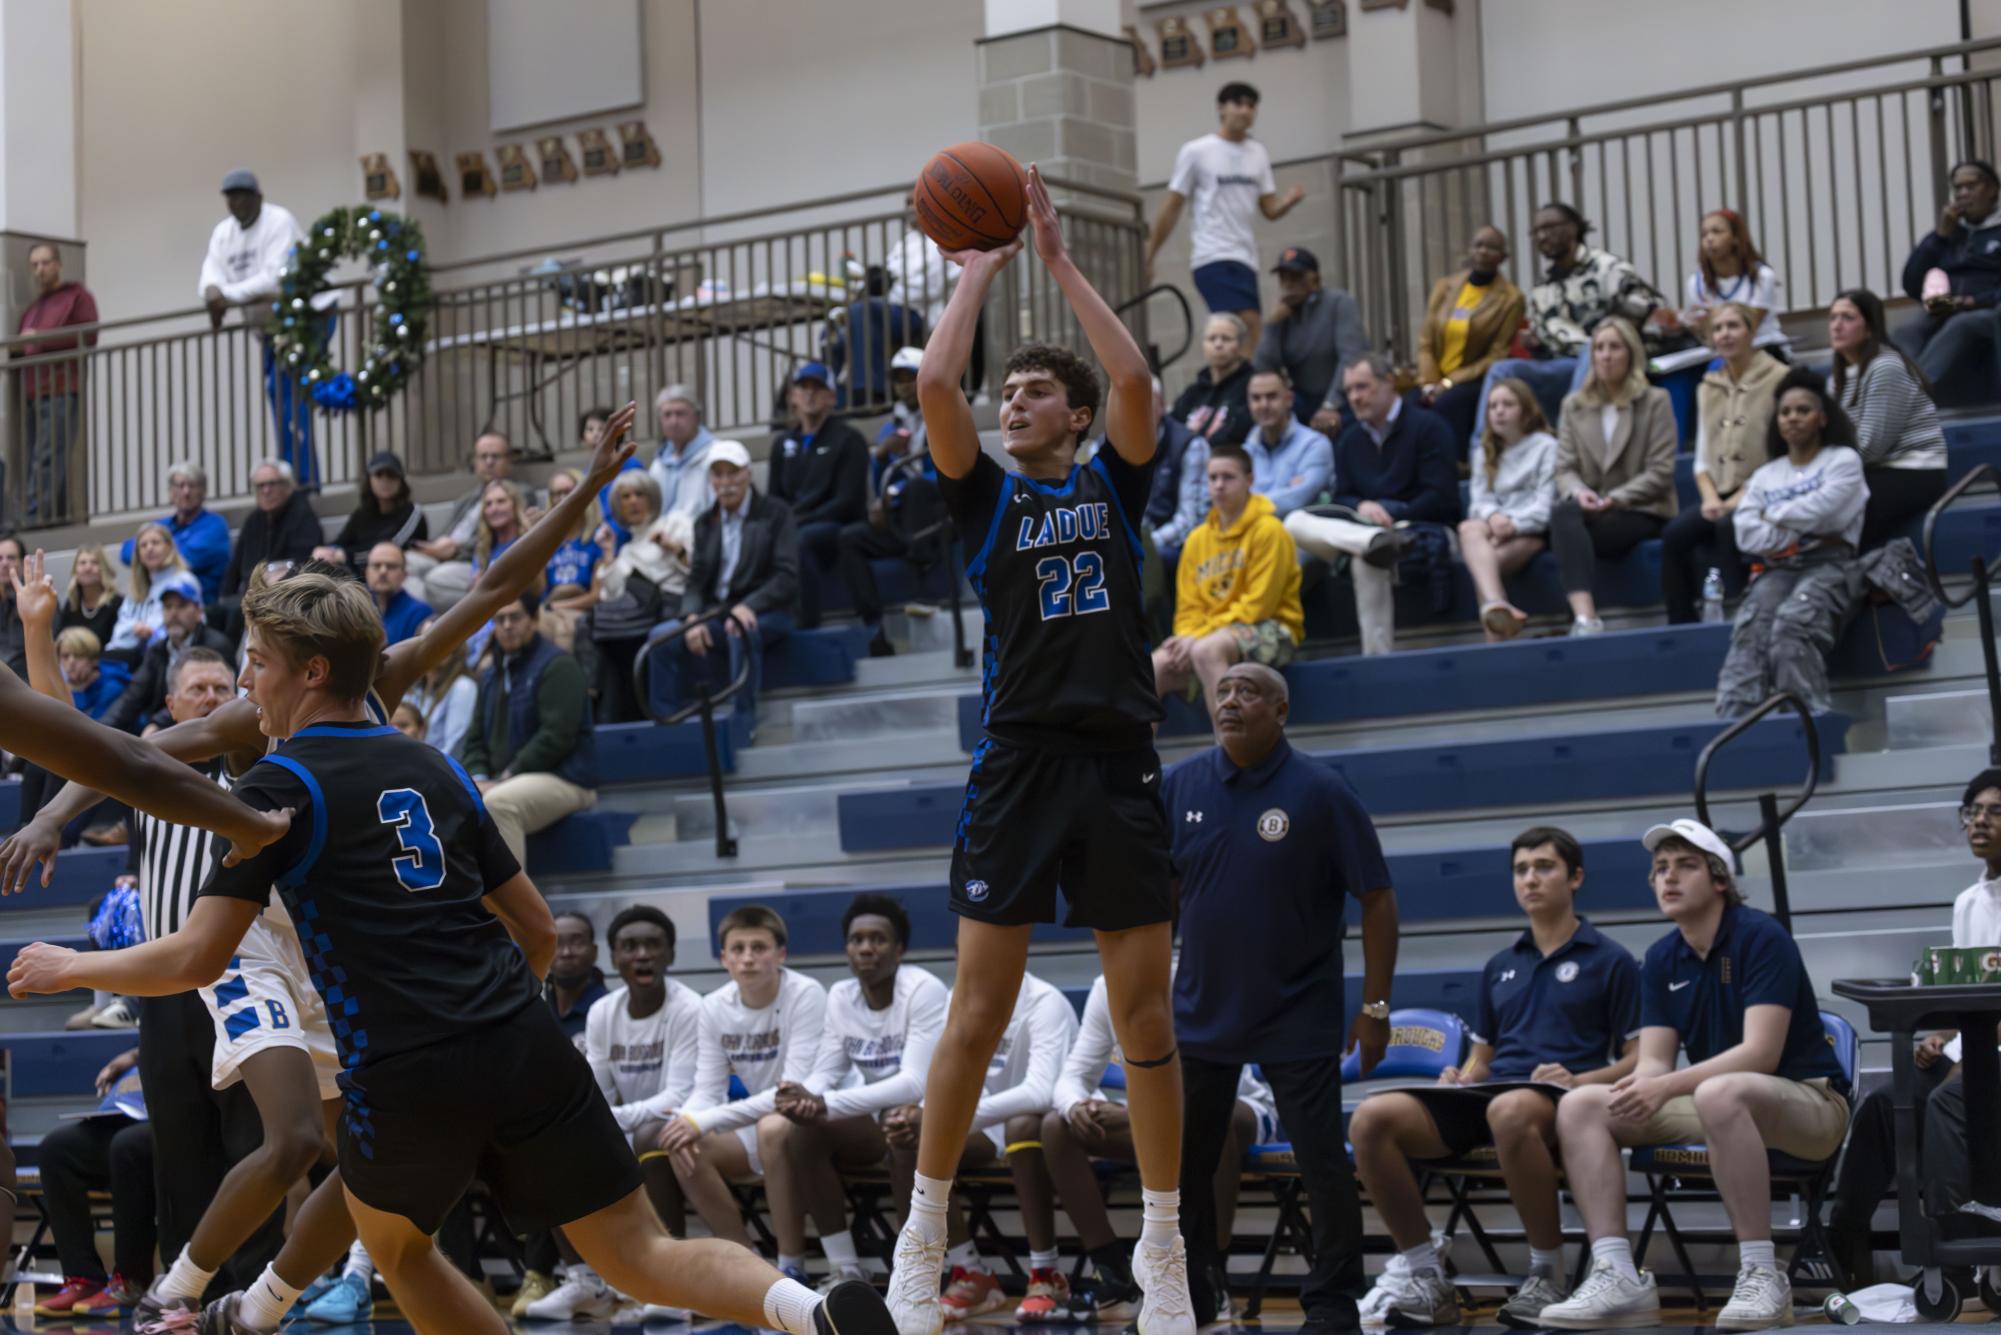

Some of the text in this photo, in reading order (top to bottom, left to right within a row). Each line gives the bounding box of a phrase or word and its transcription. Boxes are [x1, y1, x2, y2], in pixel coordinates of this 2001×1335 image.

[1016, 502, 1110, 551] LADUE
[1035, 551, 1110, 621] 22
[377, 788, 447, 892] 3
[1269, 818, 1279, 832] B
[264, 998, 290, 1029] B
